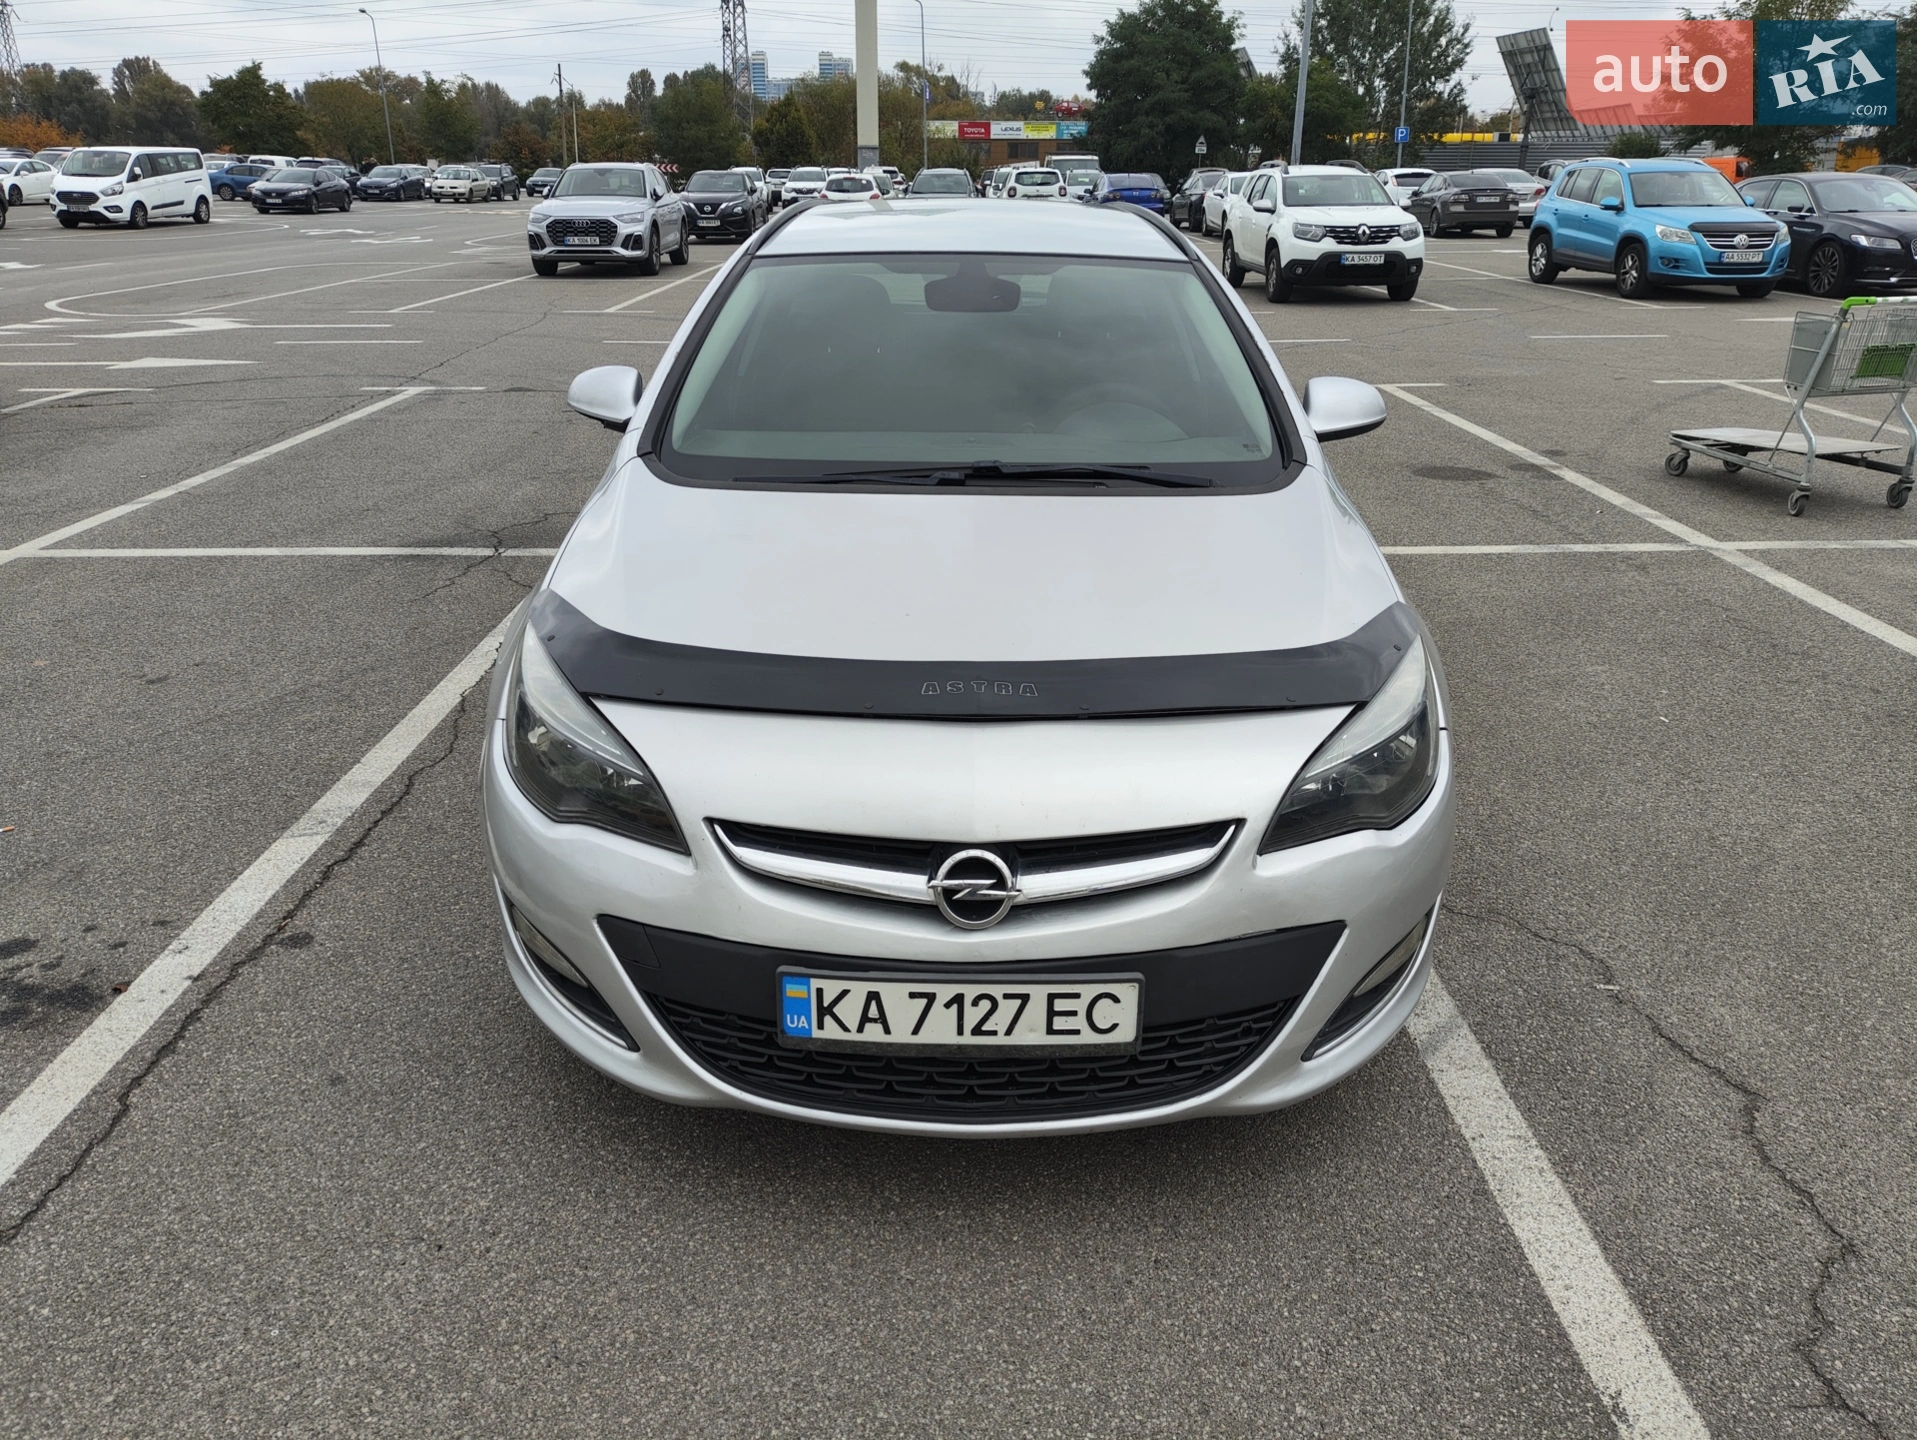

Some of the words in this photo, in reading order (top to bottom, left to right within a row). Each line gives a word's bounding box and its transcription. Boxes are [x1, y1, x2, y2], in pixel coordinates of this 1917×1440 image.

[1398, 128, 1407, 141] P
[1345, 255, 1356, 263] KA
[1357, 255, 1373, 263] 3457
[1373, 255, 1383, 263] OT
[1725, 253, 1735, 261] AA
[920, 680, 1039, 697] ASTRA
[815, 987, 892, 1035] KA
[908, 991, 1031, 1036] 7127
[1046, 991, 1121, 1036] EC
[786, 1013, 809, 1029] UA
